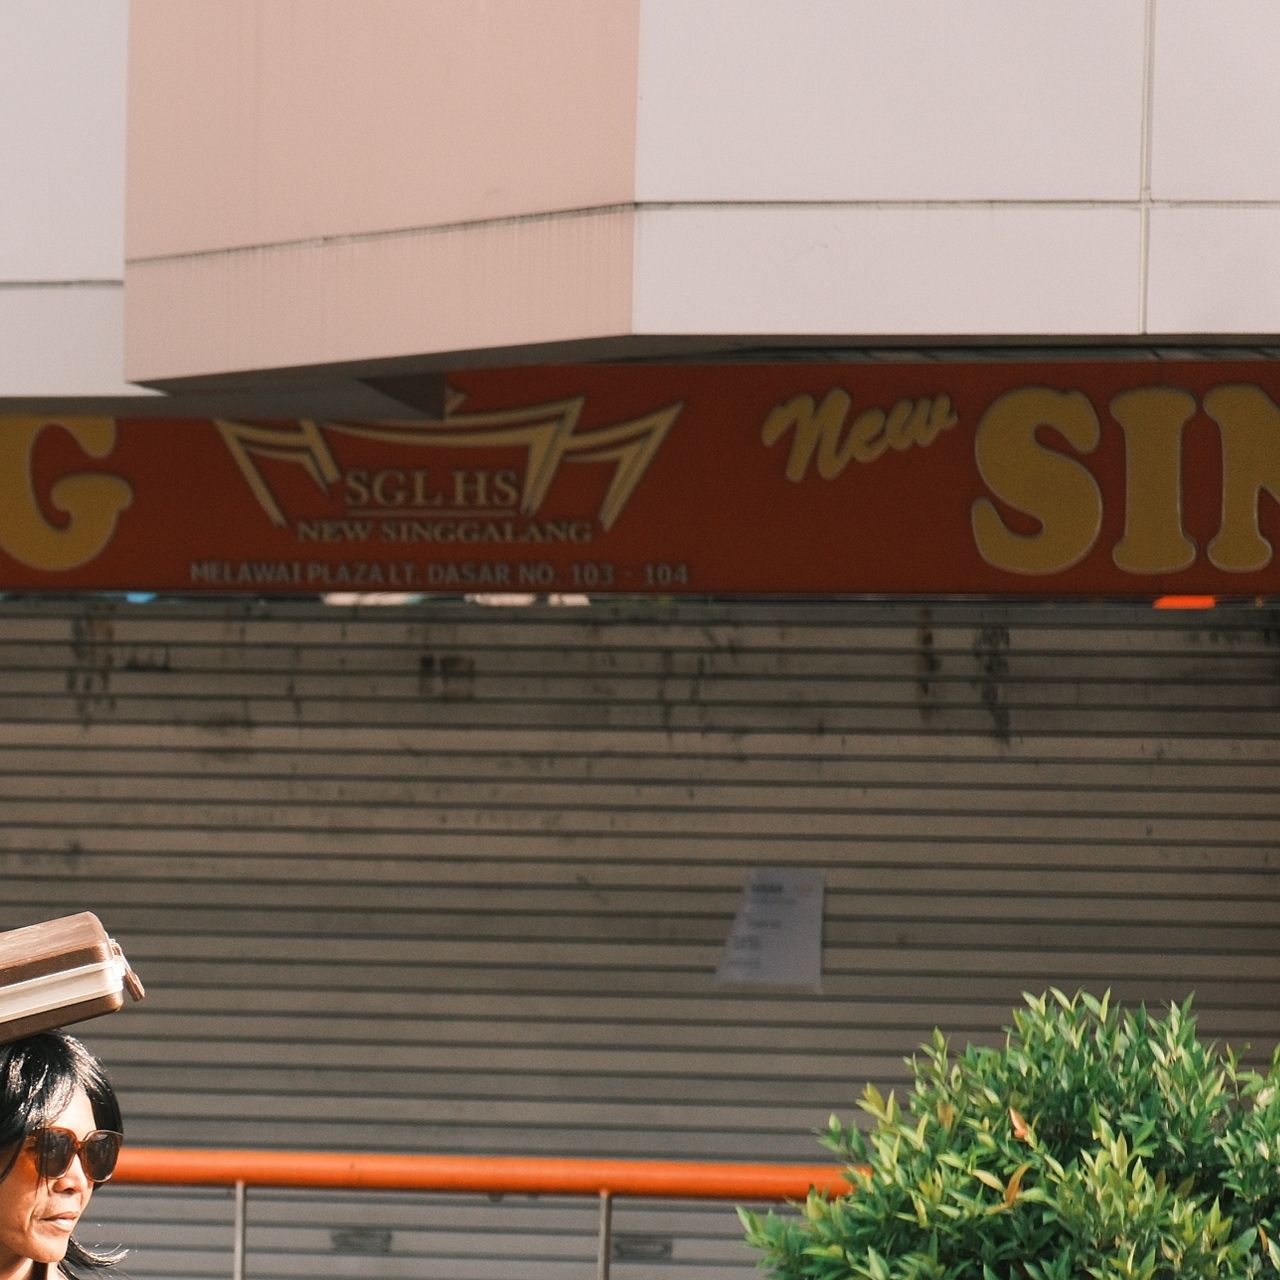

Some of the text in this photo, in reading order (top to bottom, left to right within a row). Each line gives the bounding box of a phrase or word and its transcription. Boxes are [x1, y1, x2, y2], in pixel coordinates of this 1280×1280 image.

[761, 387, 959, 483] New
[344, 468, 518, 507] SGL HS
[296, 519, 593, 544] NEW SINGGALANG
[190, 560, 301, 584] MELAWAI
[306, 561, 385, 584] PLAZA
[427, 562, 511, 585] DASAR
[571, 562, 614, 586] 103
[645, 562, 689, 586] 104
